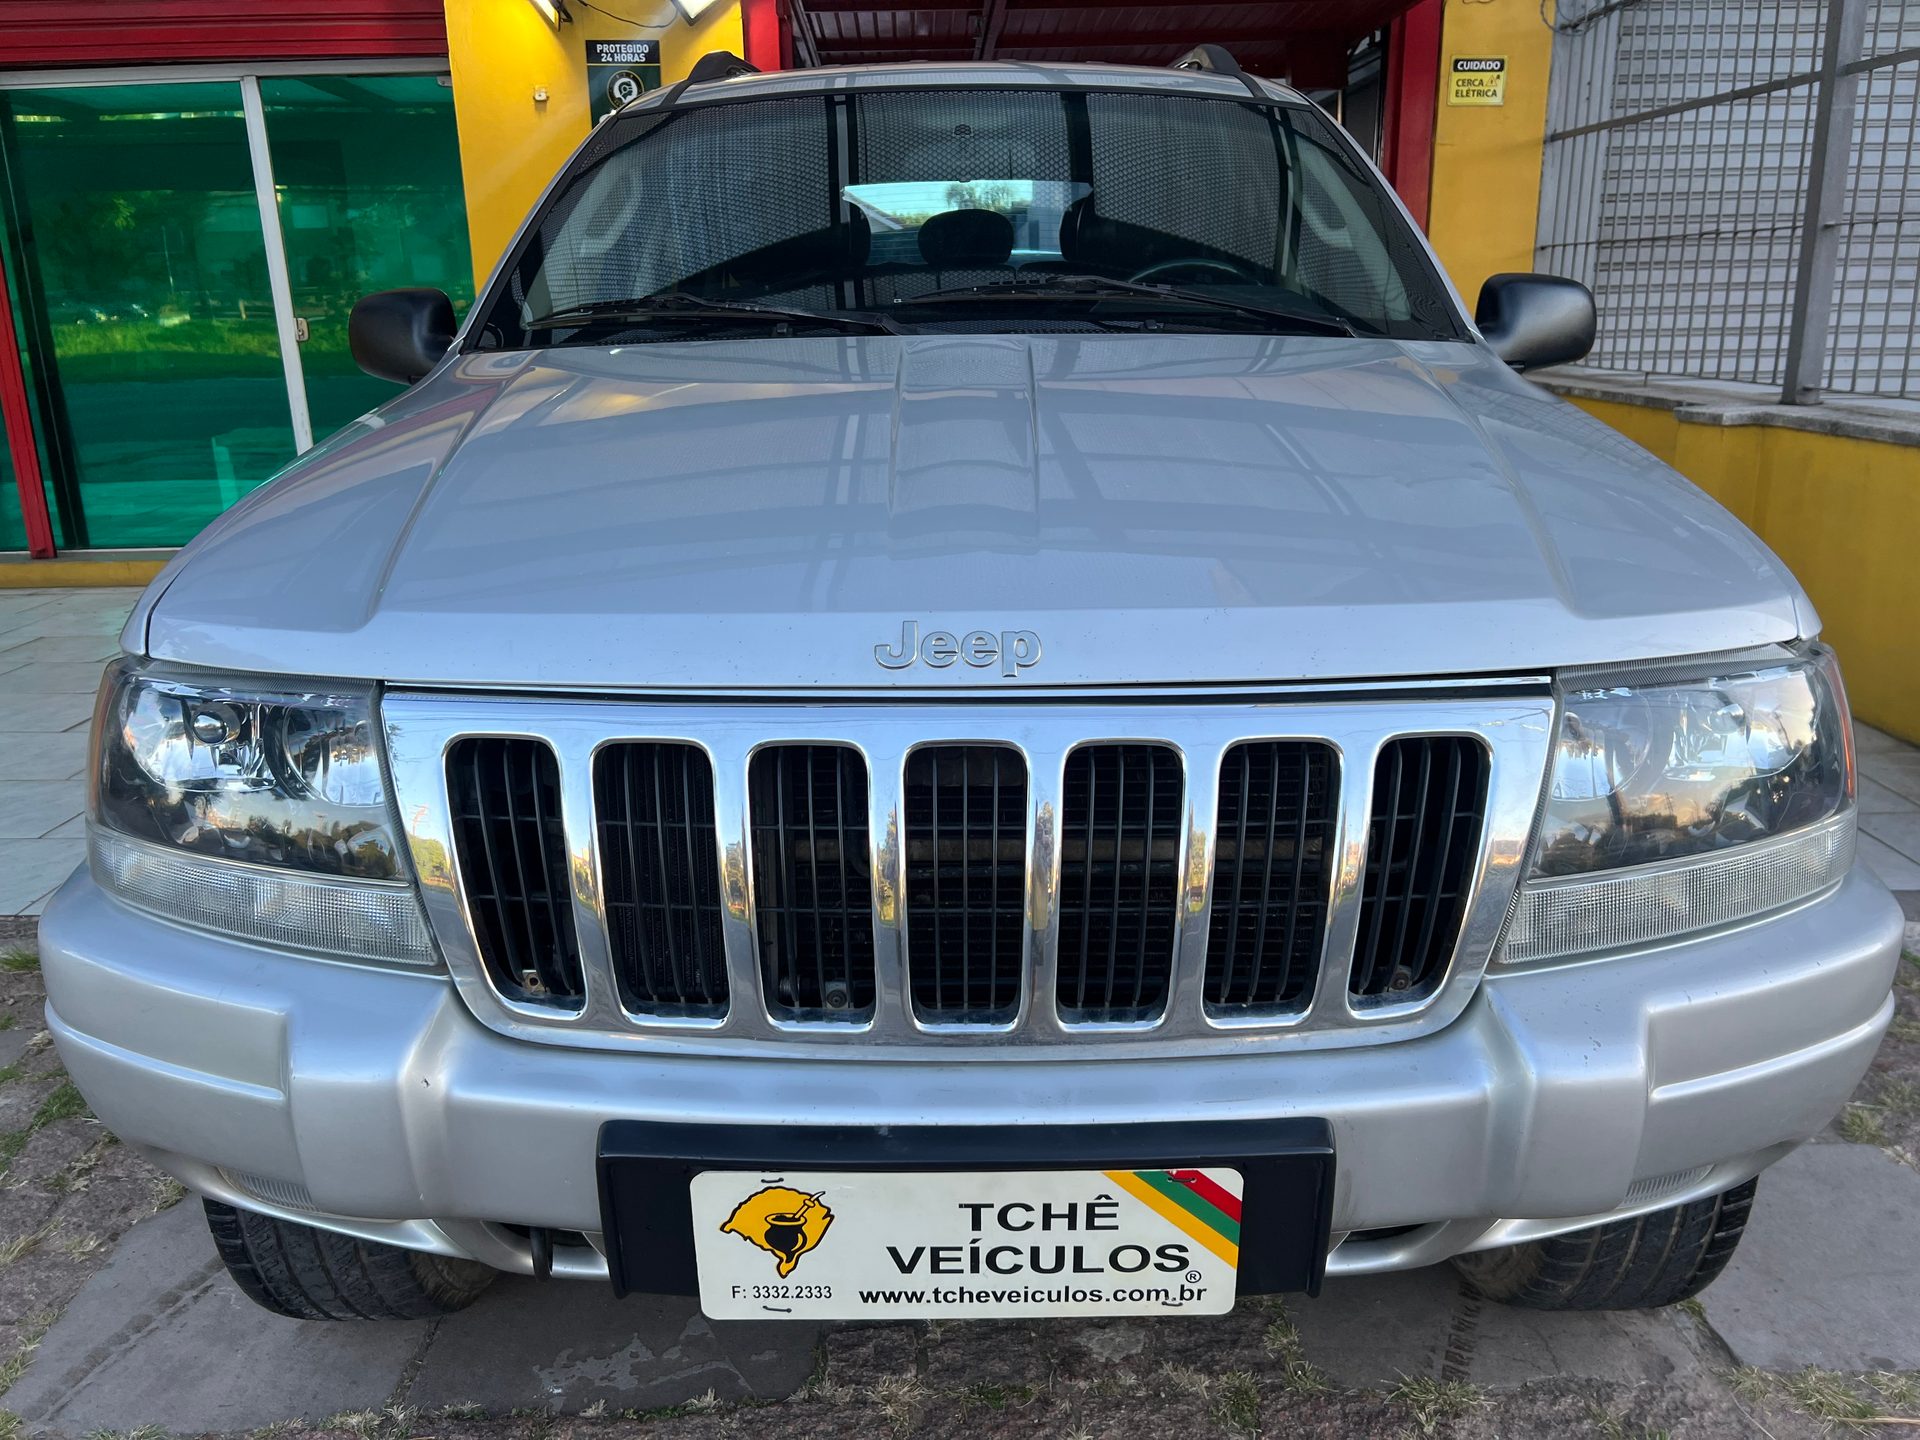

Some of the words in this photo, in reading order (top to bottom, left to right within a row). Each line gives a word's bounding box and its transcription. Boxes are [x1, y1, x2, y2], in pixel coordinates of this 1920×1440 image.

[596, 43, 649, 53] PROTEGIDO
[601, 53, 613, 62] 24
[614, 53, 646, 62] HORAS
[1457, 60, 1501, 70] CUIDADO
[1456, 78, 1484, 87] CERCA
[1455, 87, 1497, 97] ELÉTRICA
[874, 620, 1042, 677] Jeep
[958, 1194, 1119, 1232] TCHÊ
[886, 1238, 1190, 1275] VEÍCULOS
[731, 1285, 747, 1299] F:
[752, 1285, 832, 1299] 3332.2333
[859, 1284, 1207, 1304] www.tcheveiculos.com.br
